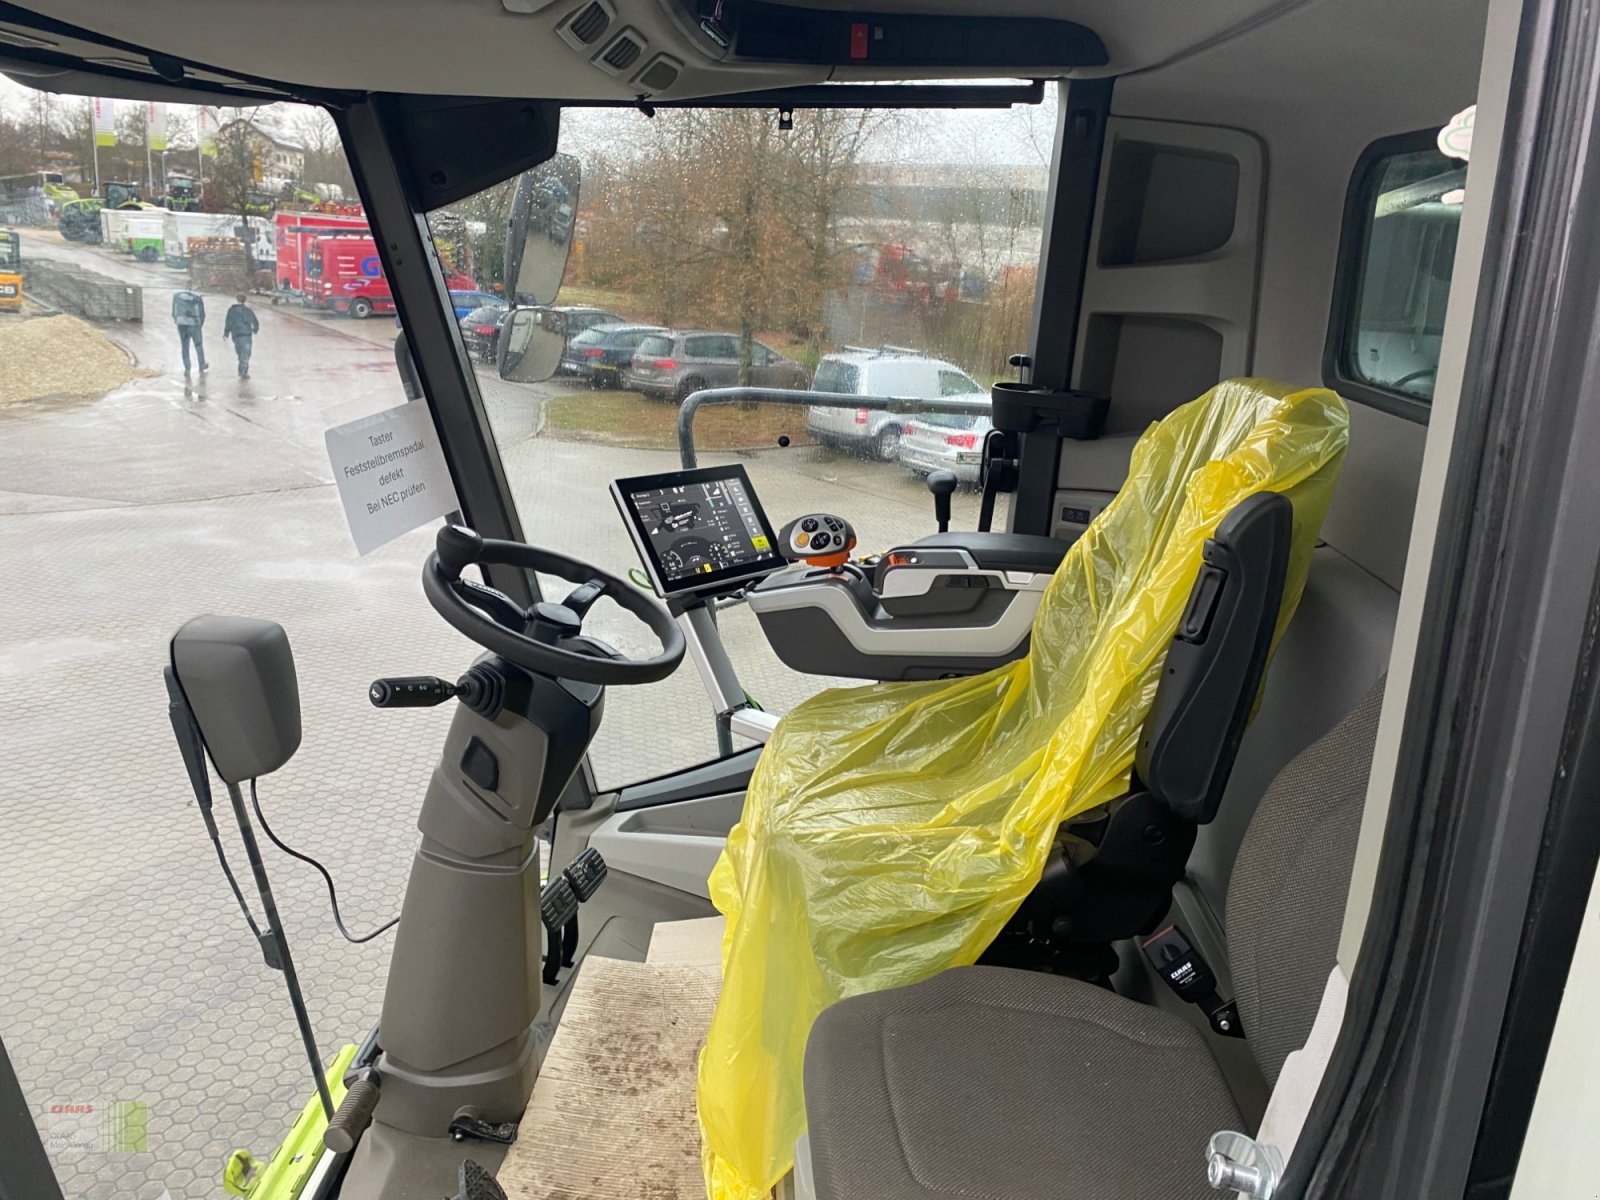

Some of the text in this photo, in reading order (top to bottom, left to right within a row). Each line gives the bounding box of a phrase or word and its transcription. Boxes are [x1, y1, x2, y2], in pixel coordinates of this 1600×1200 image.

[368, 431, 394, 447] Taster
[344, 439, 425, 479] Feststellbremspedal
[379, 468, 404, 486] defekt
[367, 482, 426, 514] Bei NEC prüfen
[1170, 961, 1192, 979] CLAAS
